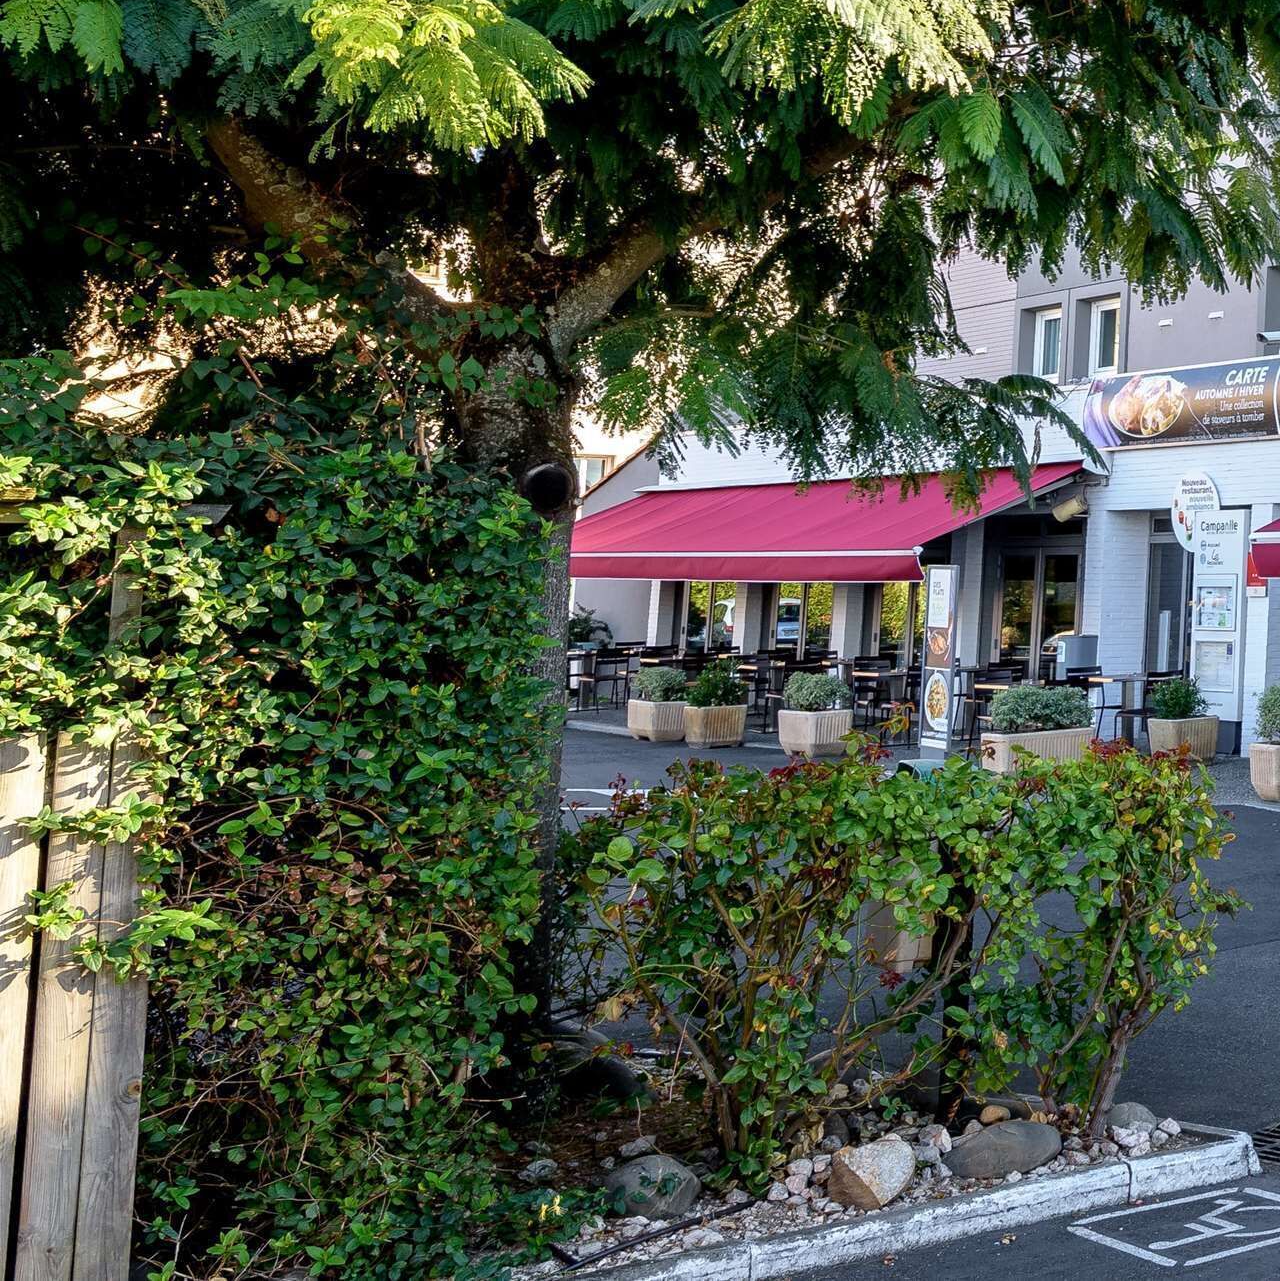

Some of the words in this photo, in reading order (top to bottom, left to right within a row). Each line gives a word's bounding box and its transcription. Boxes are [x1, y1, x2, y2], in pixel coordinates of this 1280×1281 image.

[1225, 366, 1270, 386] CARTE
[1195, 389, 1233, 400] AUTOMNE
[1240, 384, 1264, 397] HIVER
[1219, 401, 1233, 411] Une
[1234, 398, 1264, 410] collection
[1202, 414, 1211, 424] de
[1212, 415, 1235, 424] saveurs
[1242, 412, 1265, 422] tomber
[1181, 479, 1207, 487] Nouveau
[1200, 519, 1239, 534] Campanile
